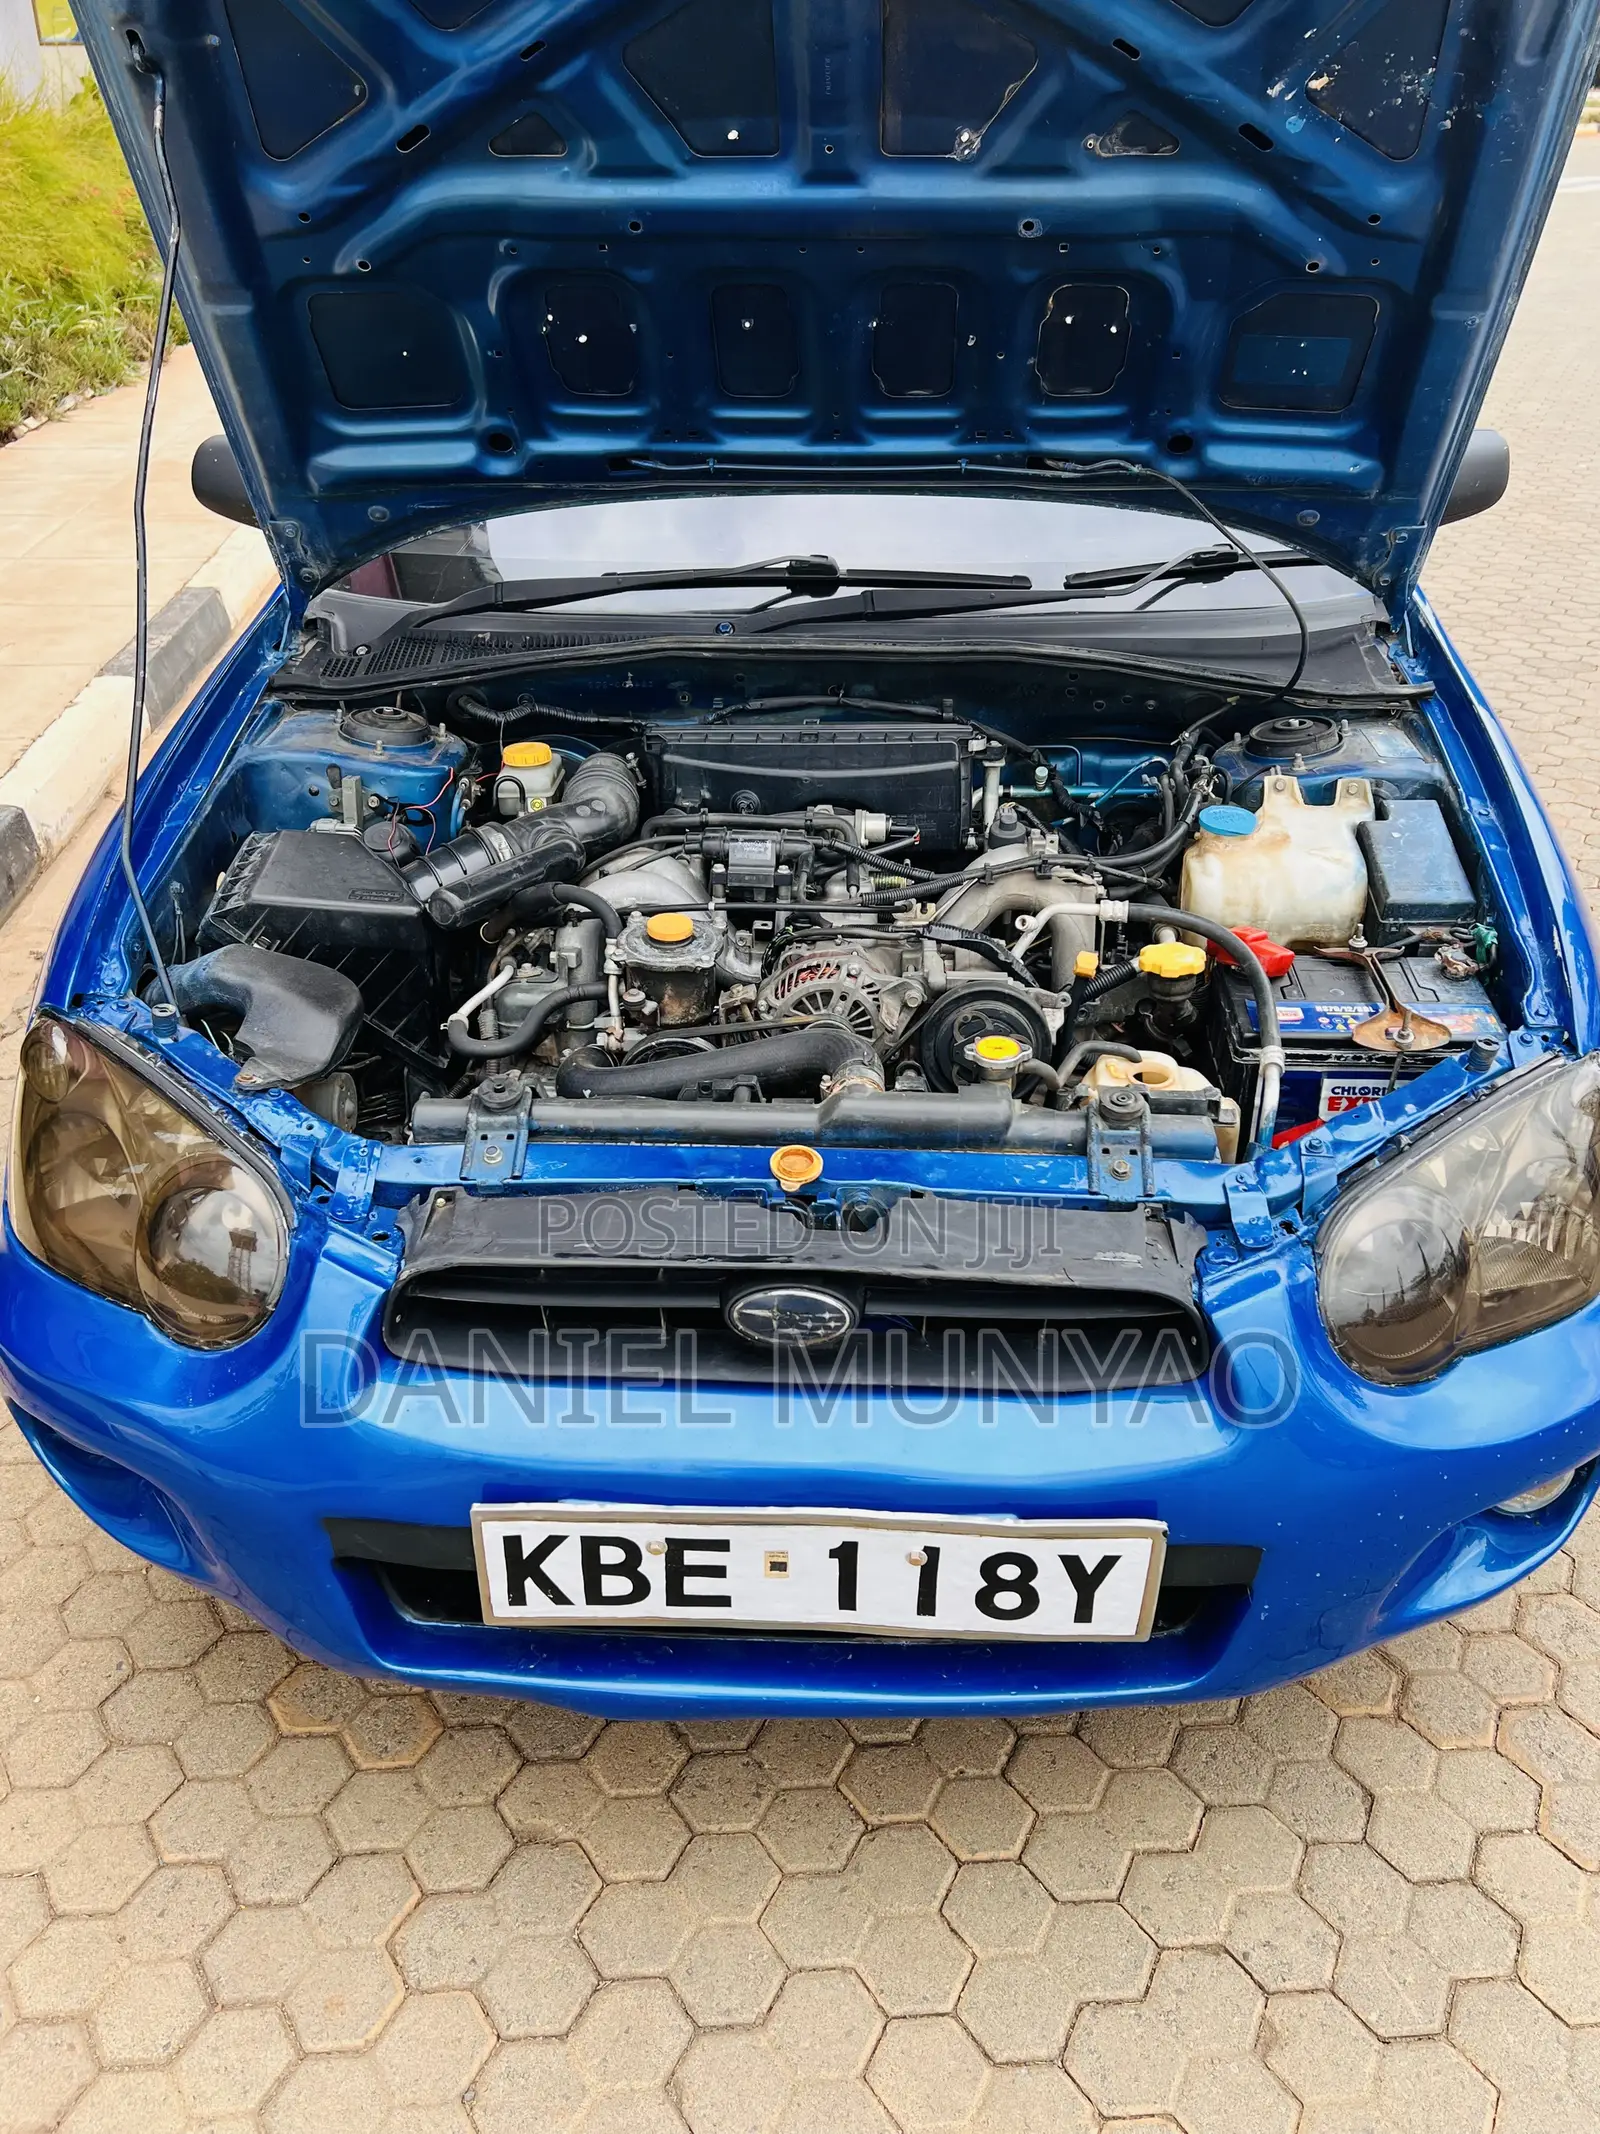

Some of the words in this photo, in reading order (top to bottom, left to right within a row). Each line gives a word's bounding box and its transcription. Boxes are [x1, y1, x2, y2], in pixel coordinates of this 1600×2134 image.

[1331, 1086, 1400, 1097] CHLORI
[502, 1534, 732, 1608] KBE
[828, 1540, 1123, 1624] 118Y
